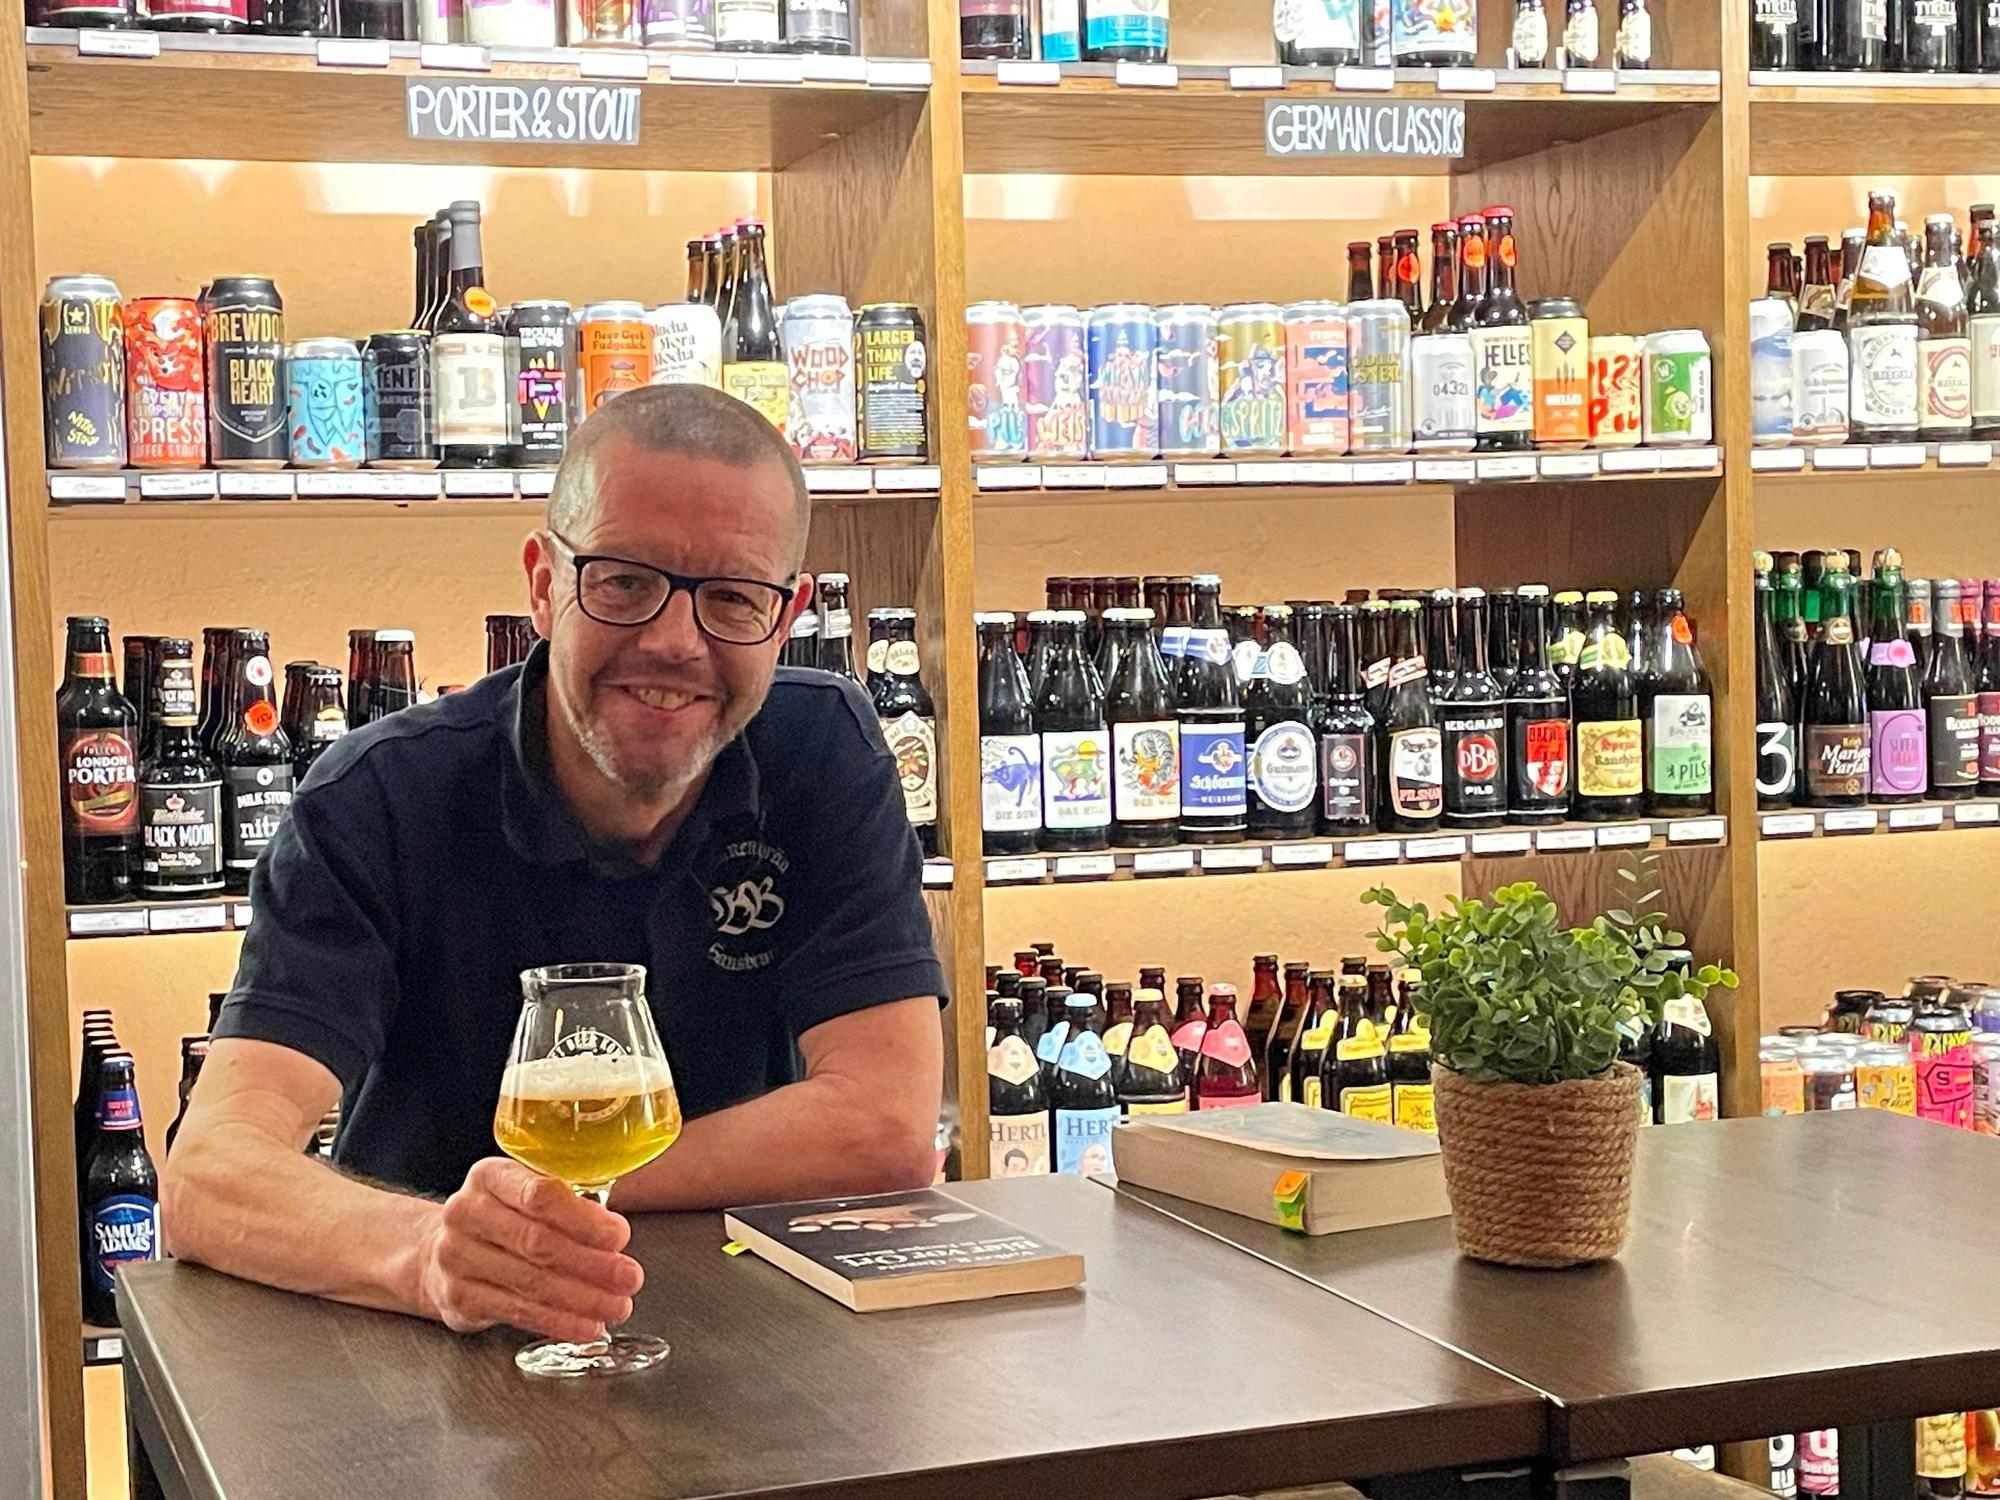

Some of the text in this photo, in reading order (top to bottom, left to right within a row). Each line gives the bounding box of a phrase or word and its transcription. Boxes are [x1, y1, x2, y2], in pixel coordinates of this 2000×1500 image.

[408, 83, 534, 139] PORTER
[557, 84, 641, 142] STOUT
[1267, 104, 1465, 156] GERMAN CLASSICS
[866, 330, 915, 346] LARGER
[791, 344, 849, 369] WOOD
[867, 347, 903, 362] THAN
[229, 358, 276, 383] BLACK
[230, 381, 275, 406] HEART
[76, 755, 128, 768] LONDON
[1755, 722, 1794, 797] 3
[68, 764, 137, 785] PORTER
[1679, 760, 1707, 781] PILS
[237, 792, 262, 809] MILK
[1464, 784, 1494, 796] PILS
[179, 822, 215, 848] MOON
[95, 1217, 155, 1241] SAMUEL
[98, 1237, 152, 1255] ADAMS
[842, 1253, 908, 1268] Ort
